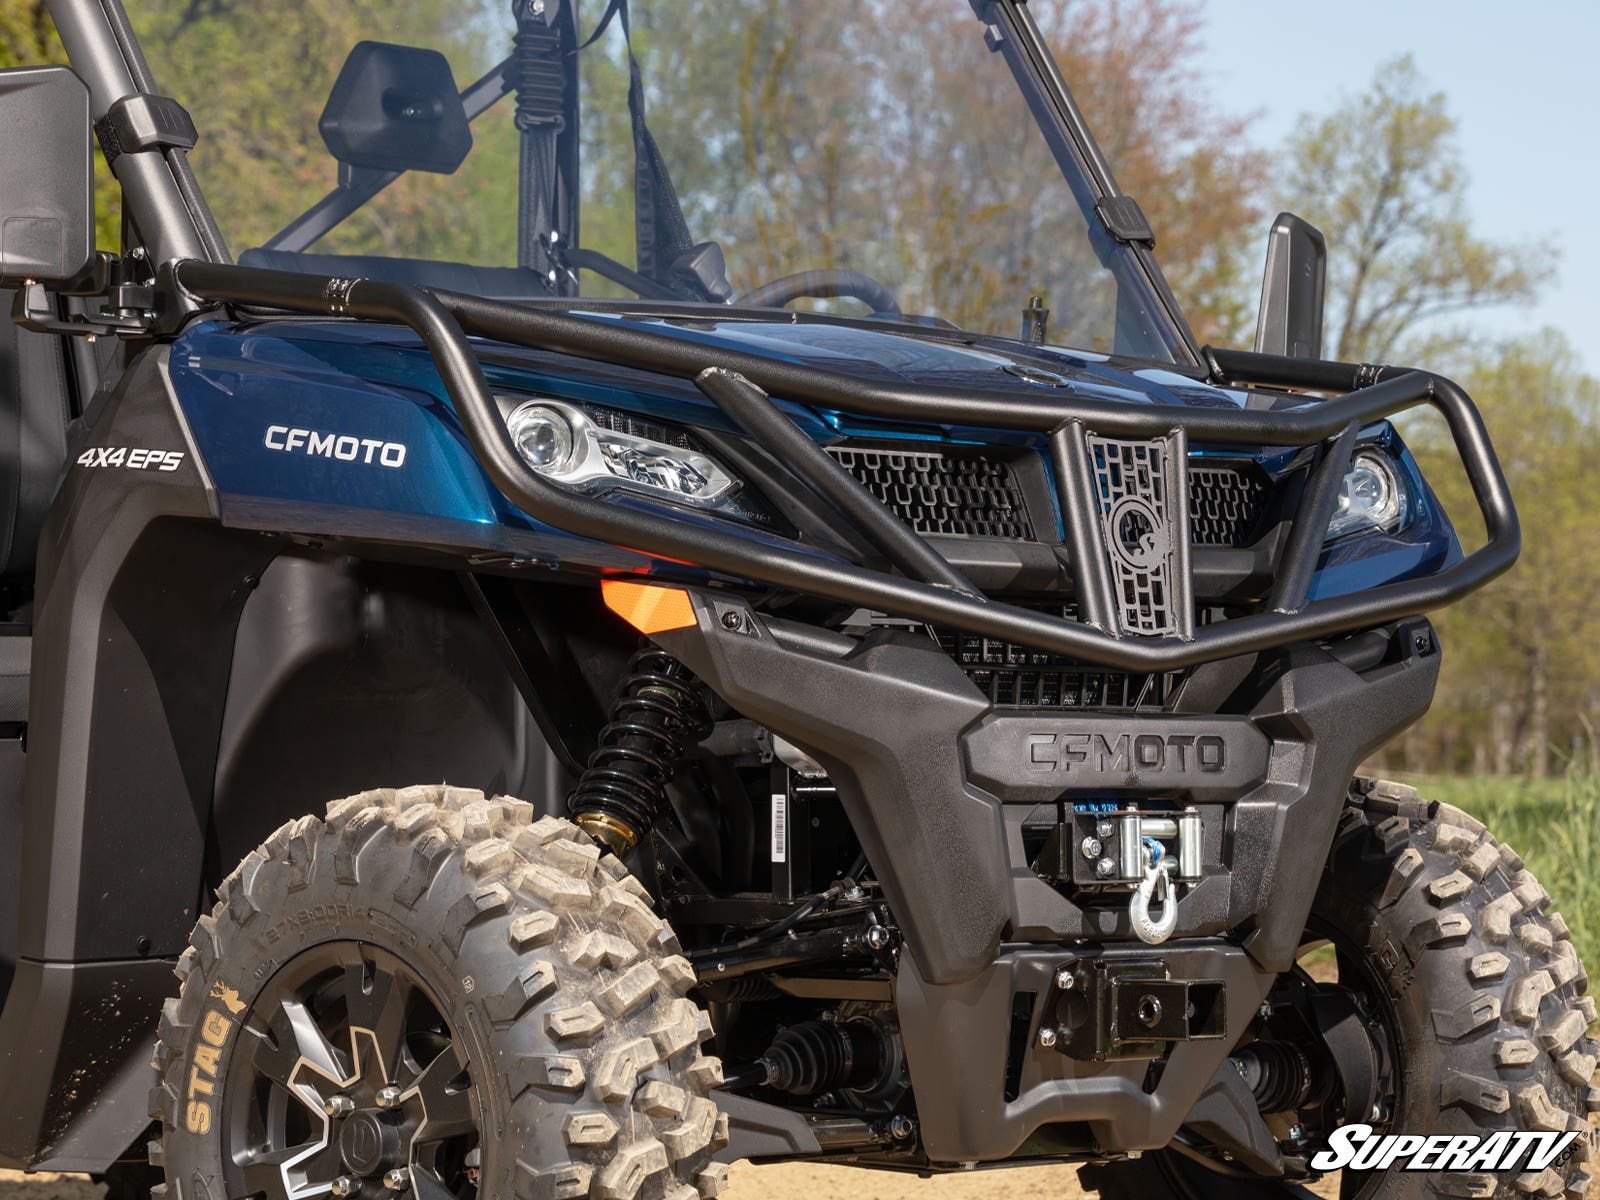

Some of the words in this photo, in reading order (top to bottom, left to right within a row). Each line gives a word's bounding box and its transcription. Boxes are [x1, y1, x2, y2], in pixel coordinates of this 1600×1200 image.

[264, 425, 407, 469] CFMOTO
[1025, 733, 1226, 772] CFMOTO
[185, 1008, 233, 1135] STAG
